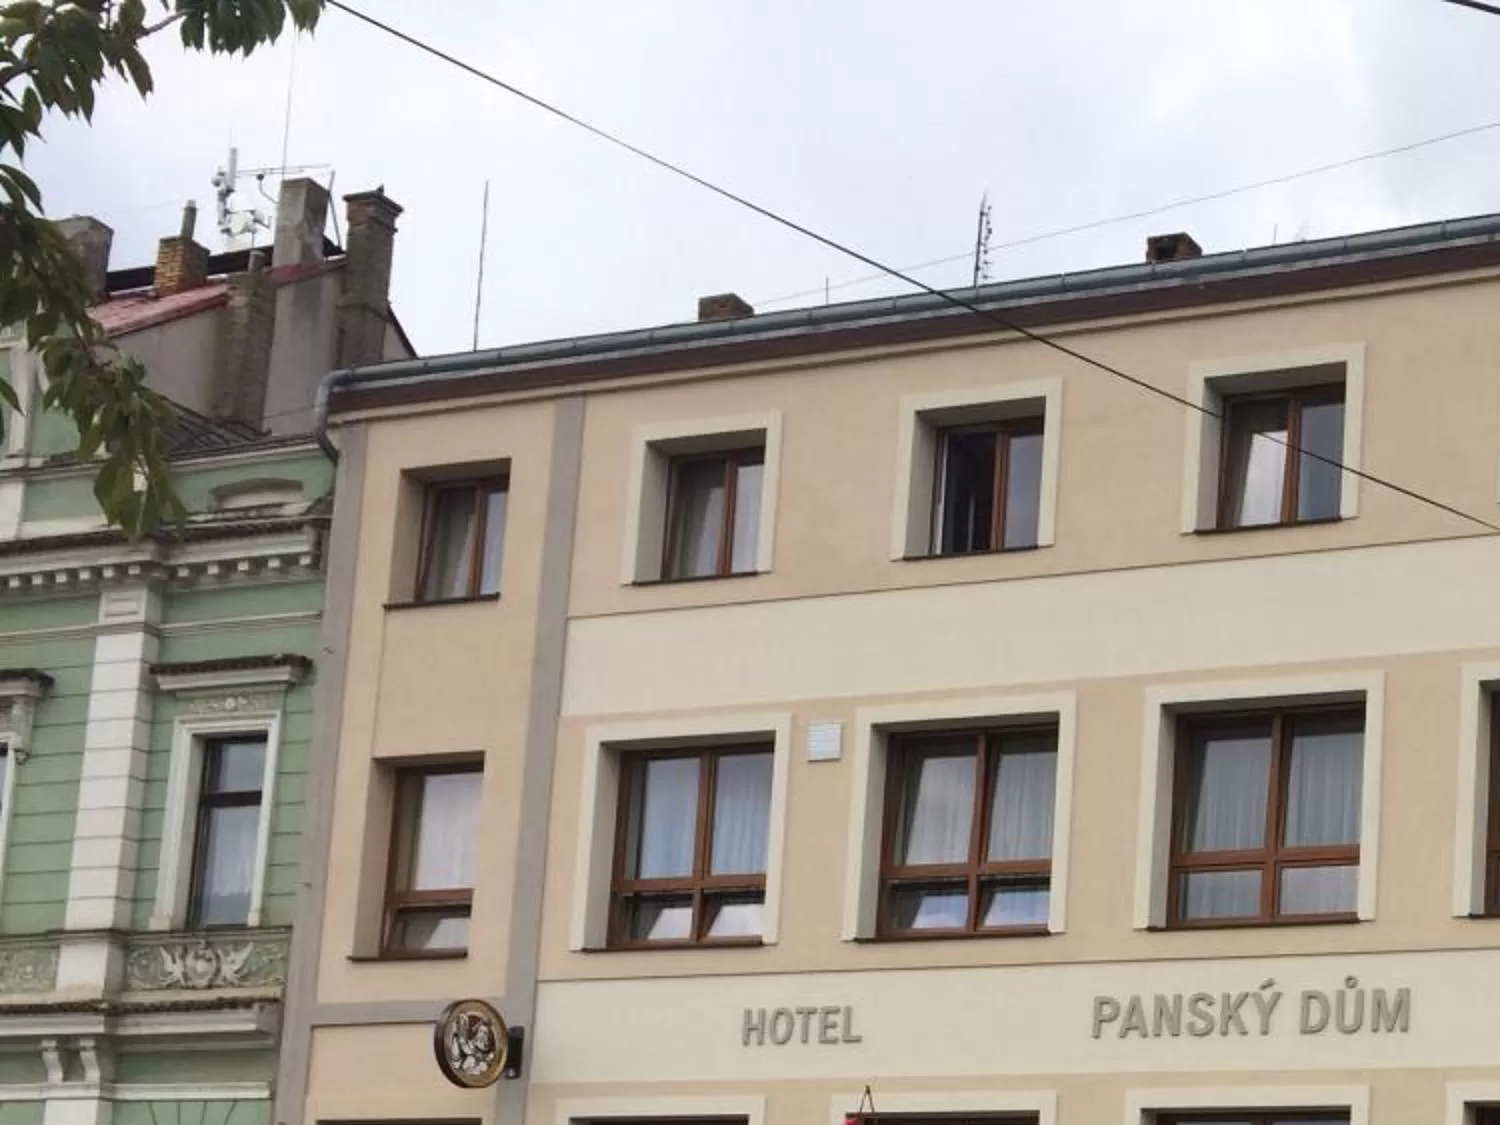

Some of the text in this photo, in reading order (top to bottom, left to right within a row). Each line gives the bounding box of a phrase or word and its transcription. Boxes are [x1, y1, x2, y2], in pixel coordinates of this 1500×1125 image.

[742, 1005, 863, 1047] HOTEL
[1091, 975, 1411, 1040] PANSKÝ DŮM
